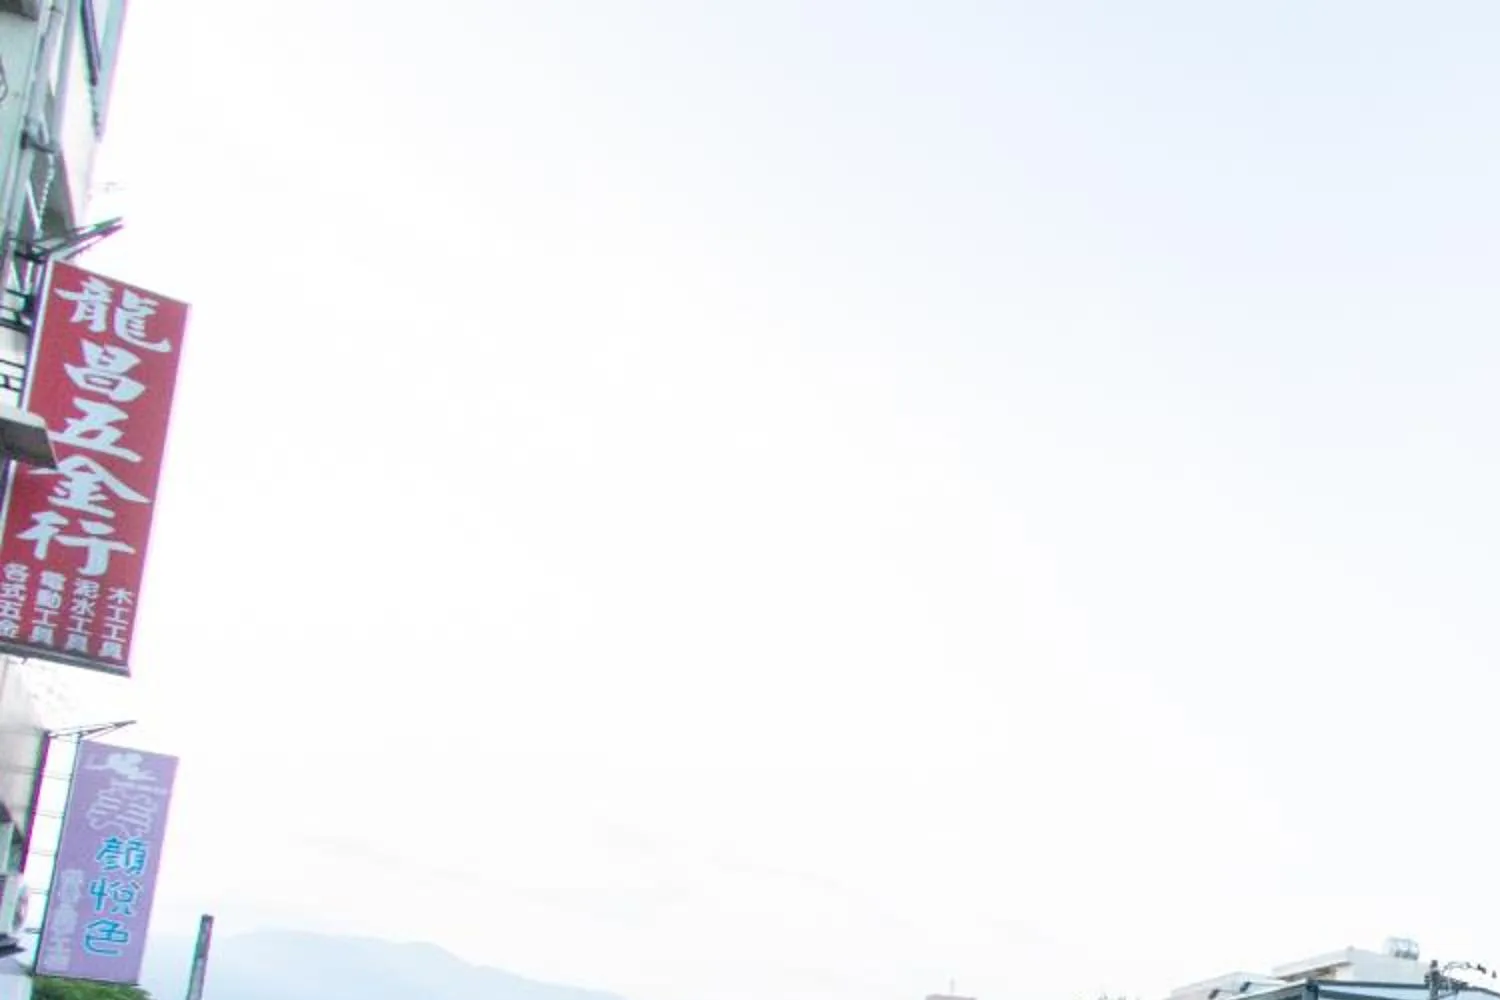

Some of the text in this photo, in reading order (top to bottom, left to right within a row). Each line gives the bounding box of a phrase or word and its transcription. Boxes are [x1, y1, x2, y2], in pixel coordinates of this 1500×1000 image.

[16, 273, 172, 577] 龍昌五金行
[98, 586, 134, 660] 木工工具
